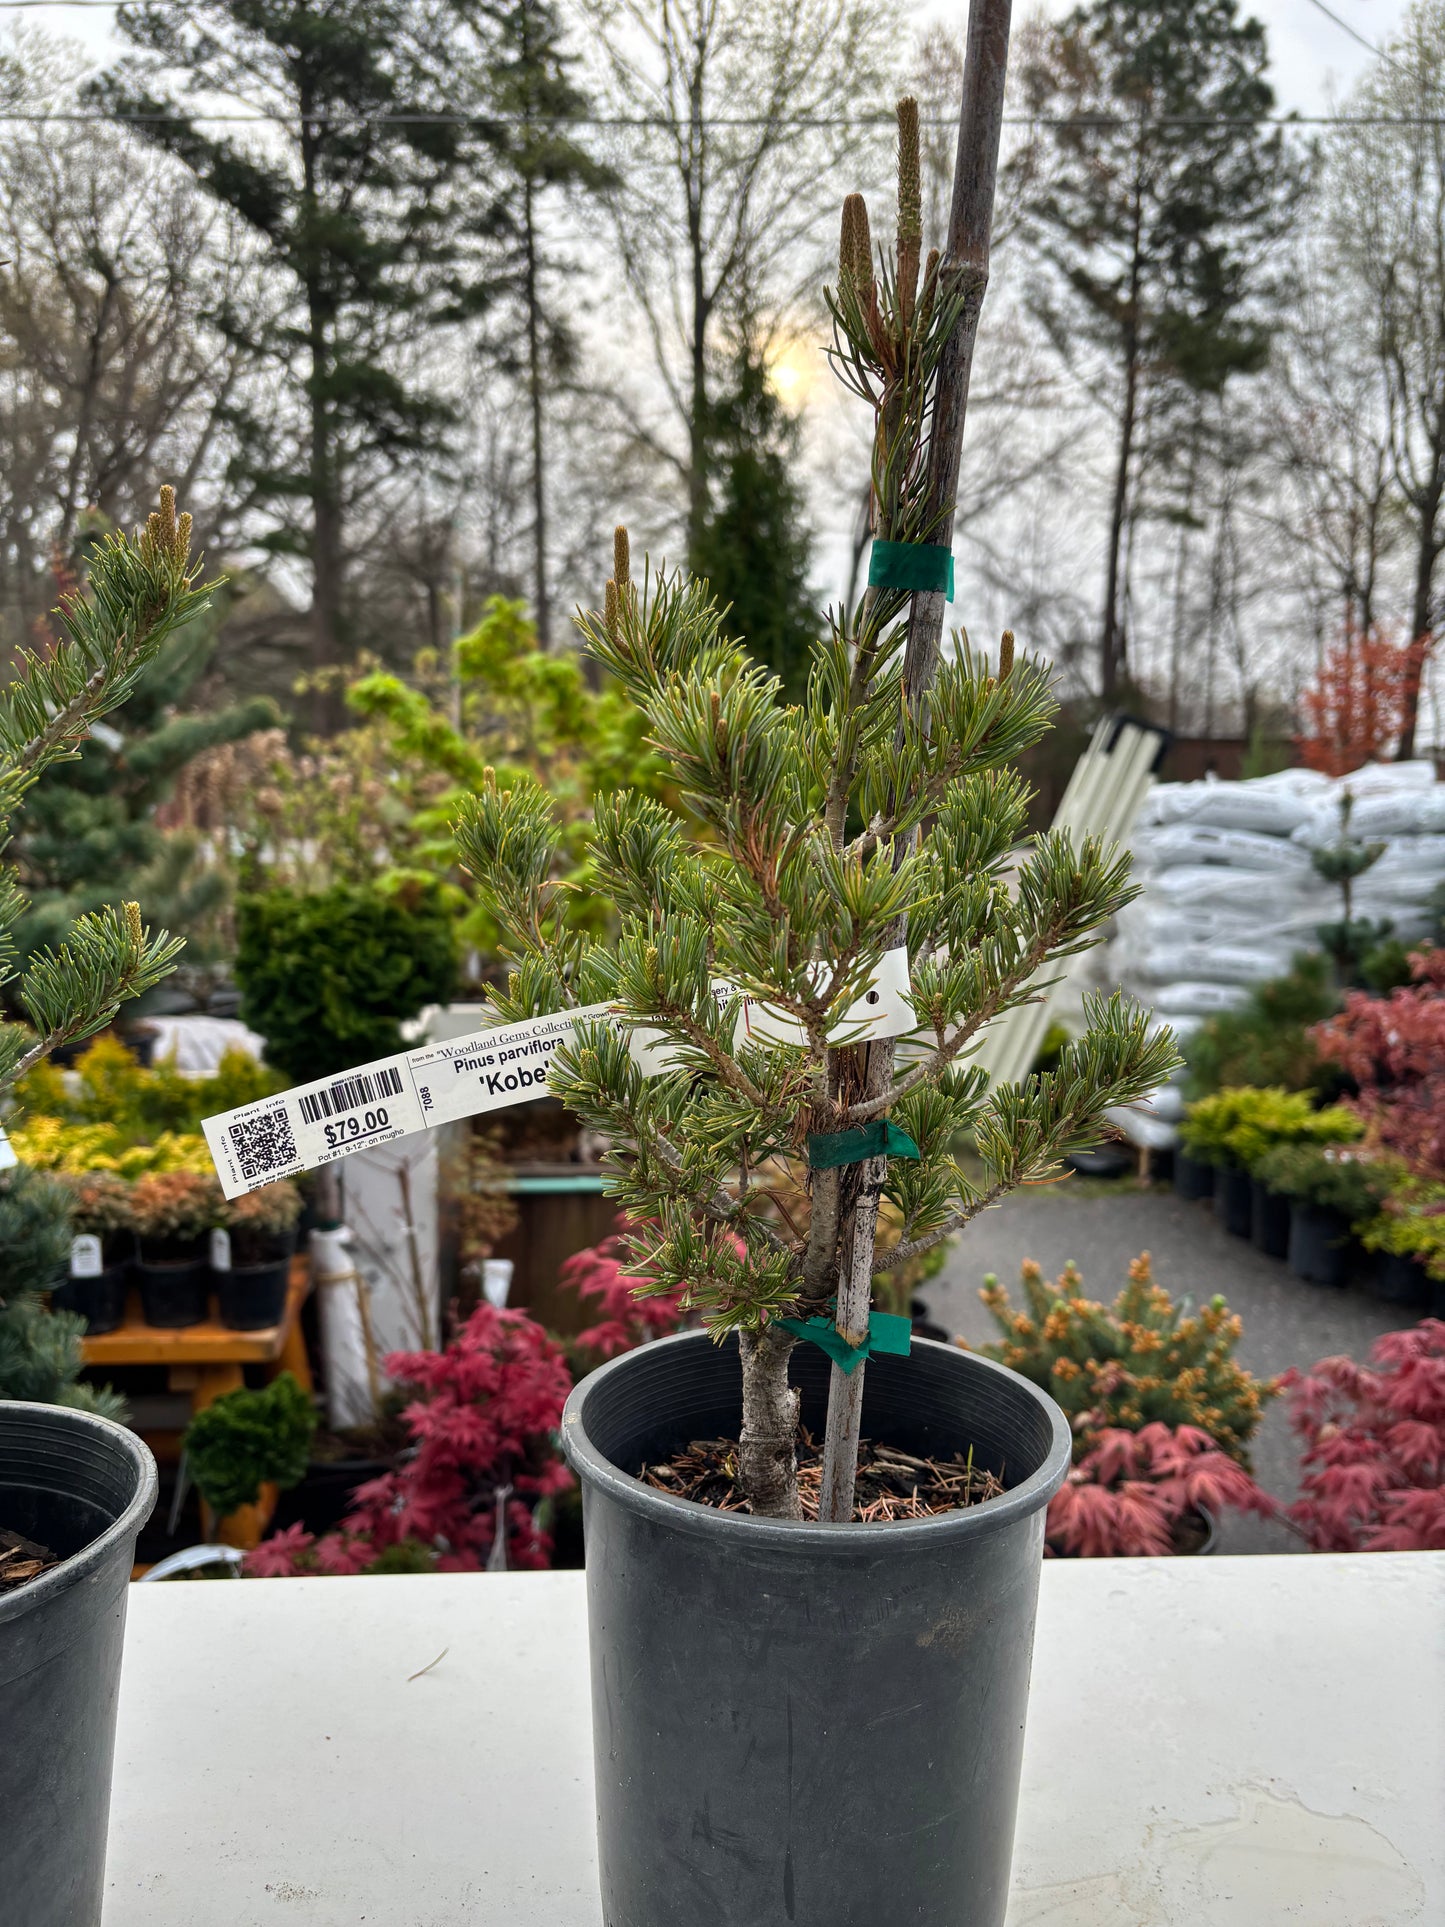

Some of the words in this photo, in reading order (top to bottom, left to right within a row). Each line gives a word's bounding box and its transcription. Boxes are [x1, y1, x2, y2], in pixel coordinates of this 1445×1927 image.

[436, 1036, 497, 1058] "Woodland
[499, 1026, 530, 1045] Gems
[454, 1054, 495, 1073] Pinus
[498, 1037, 565, 1066] parviflora
[479, 1060, 549, 1095] 'Kobe'
[233, 1107, 260, 1120] Plant
[265, 1099, 285, 1109] Info
[420, 1086, 434, 1111] 7088
[324, 1107, 389, 1147] $79.00
[220, 1135, 229, 1153] Info
[318, 1154, 331, 1162] Pot
[368, 1137, 378, 1145] on
[379, 1128, 405, 1142] mugho
[228, 1159, 238, 1183] Plant
